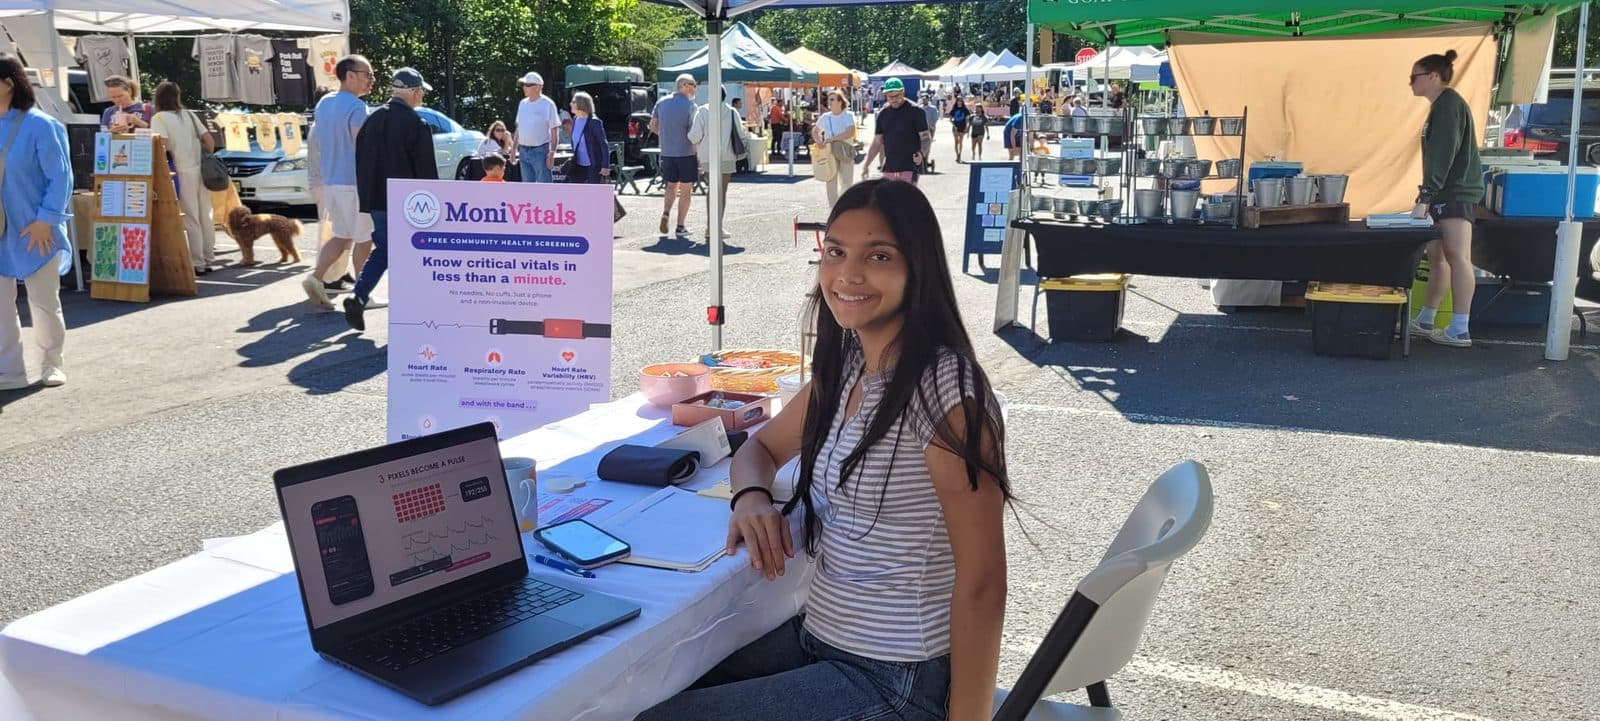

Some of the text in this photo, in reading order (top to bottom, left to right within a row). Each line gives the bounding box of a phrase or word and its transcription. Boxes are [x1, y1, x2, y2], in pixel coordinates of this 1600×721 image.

[445, 202, 577, 226] MoniVitals
[535, 240, 581, 248] SCREENING
[423, 257, 577, 271] Know critical vitals in
[432, 271, 567, 286] less than a minute.
[464, 367, 507, 375] Respiratory
[542, 372, 575, 380] Variability
[378, 474, 385, 484] 3
[388, 469, 410, 480] PIXELS
[410, 462, 440, 474] BECOME
[441, 460, 446, 468] A
[447, 455, 467, 465] PULSE
